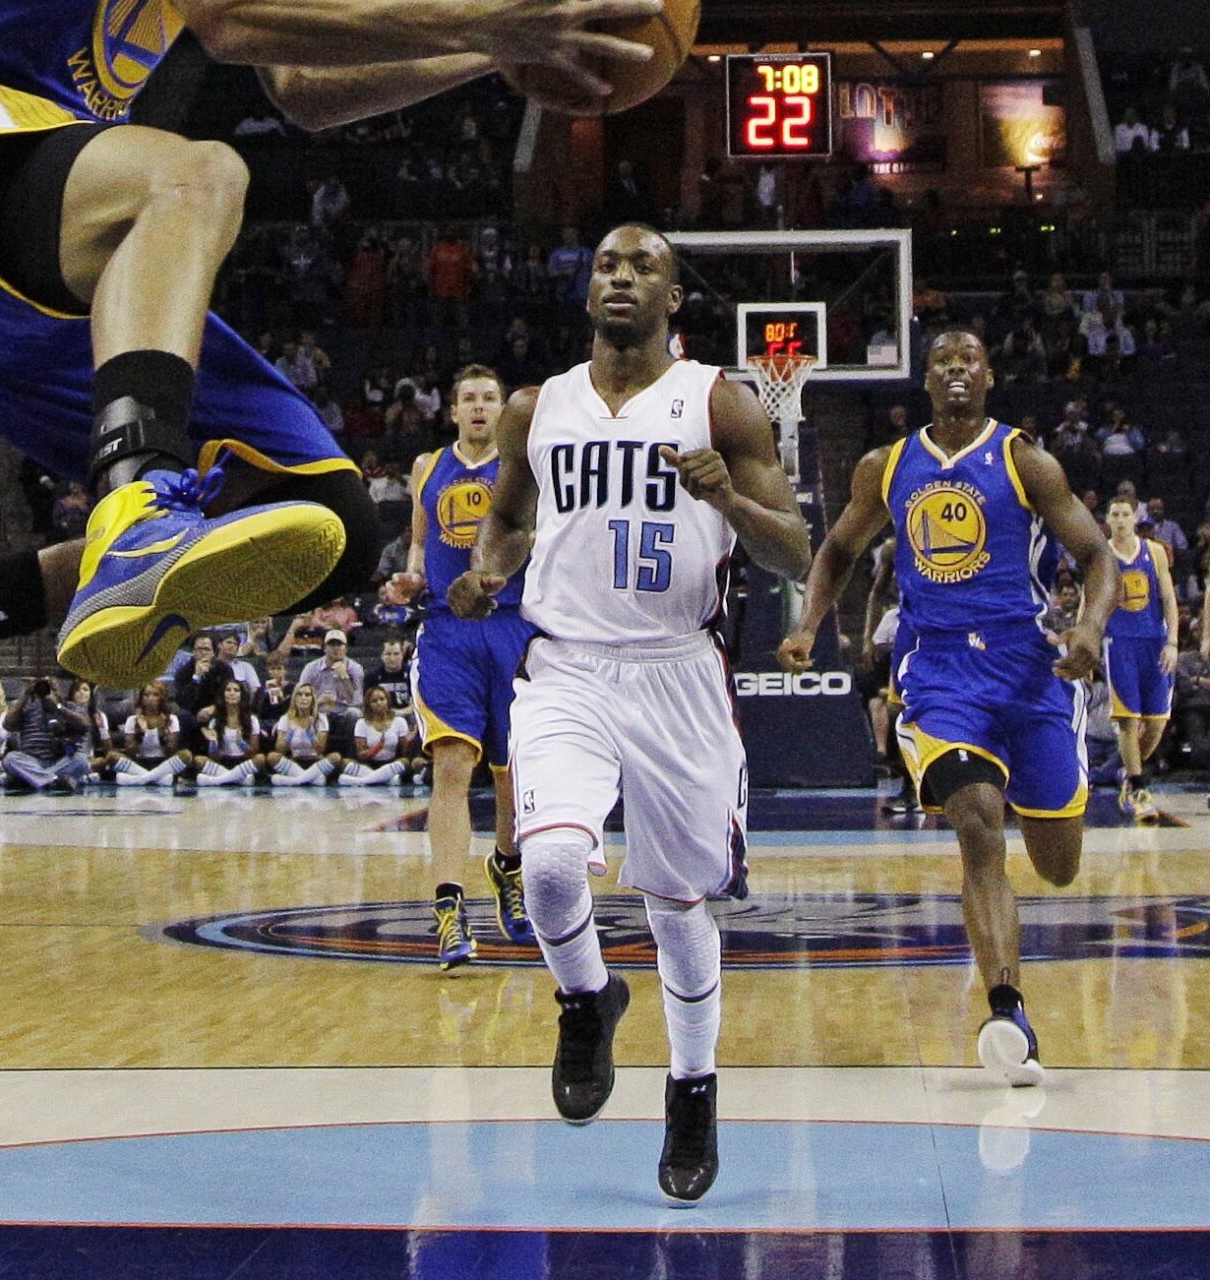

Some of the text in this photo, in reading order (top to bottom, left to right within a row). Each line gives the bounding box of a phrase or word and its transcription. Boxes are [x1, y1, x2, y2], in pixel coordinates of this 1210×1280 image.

[757, 64, 819, 94] 7:08
[747, 95, 811, 147] 22
[551, 440, 679, 513] CATS
[467, 491, 482, 507] 10
[905, 480, 987, 508] GOLDEN STATE
[941, 502, 968, 523] 40
[608, 520, 675, 593] 15
[914, 550, 991, 584] WARRIORS
[733, 671, 852, 697] GEICO
